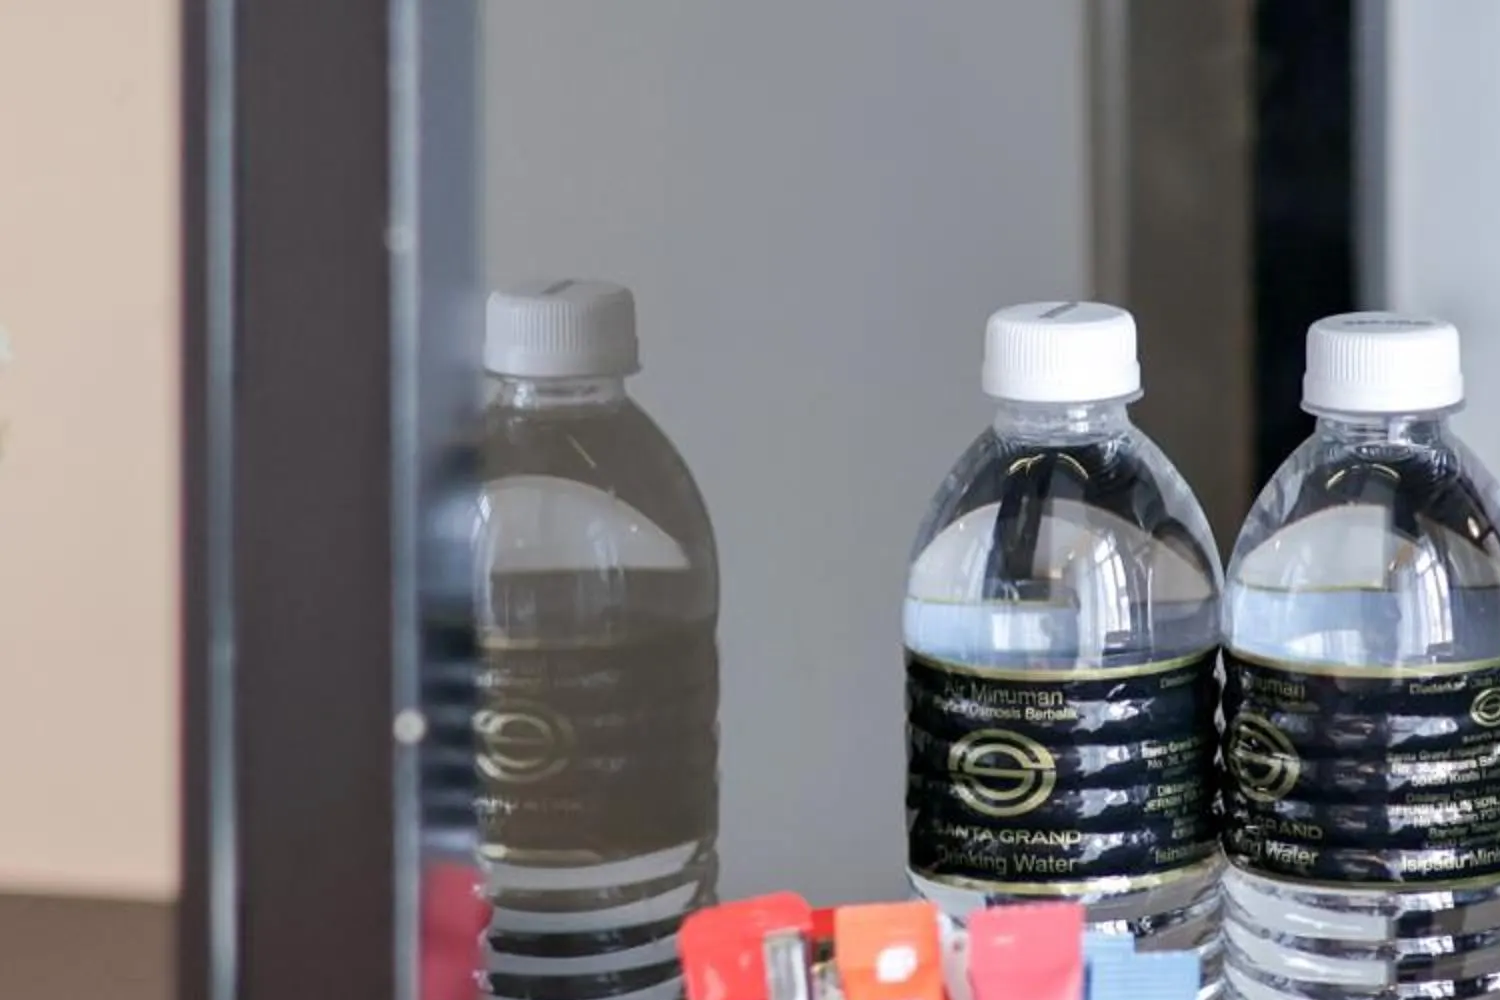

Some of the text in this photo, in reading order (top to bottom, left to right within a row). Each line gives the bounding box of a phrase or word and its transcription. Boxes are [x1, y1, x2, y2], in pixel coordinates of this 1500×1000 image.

[970, 681, 1064, 707] Minuman
[999, 829, 1082, 846] GRAND
[1013, 852, 1078, 873] Water
[1264, 839, 1320, 865] Water
